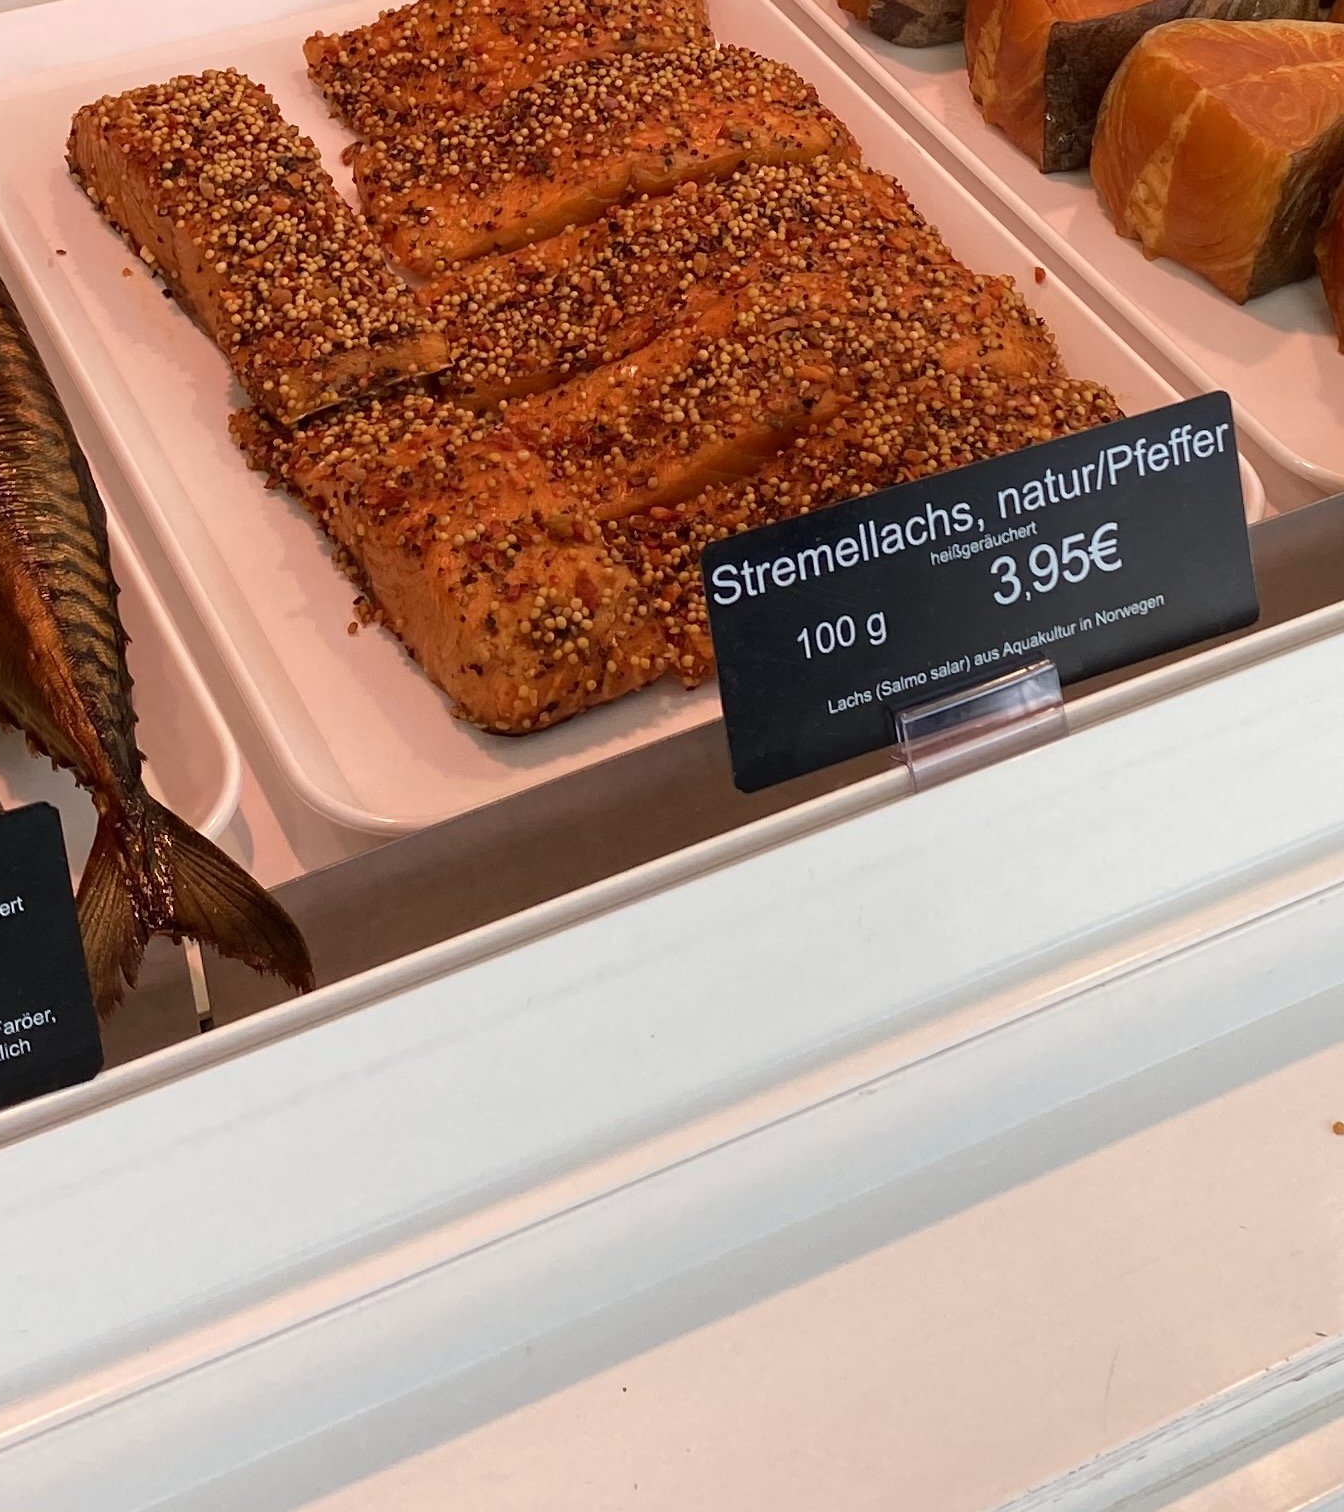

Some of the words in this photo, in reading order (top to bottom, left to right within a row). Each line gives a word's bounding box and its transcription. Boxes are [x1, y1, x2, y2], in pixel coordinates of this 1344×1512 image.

[712, 503, 984, 604] Stremellachs,
[998, 424, 1228, 518] natur/Pfeffer
[931, 522, 1037, 565] heißgeräuchert
[991, 523, 1122, 604] 3,95€
[798, 616, 855, 658] 100
[867, 612, 886, 645] g
[828, 691, 872, 713] Lachs
[876, 673, 926, 701] (Salmo
[931, 656, 970, 680] salar)
[975, 649, 1000, 665] aus
[1003, 624, 1076, 657] Aquakultur
[1080, 619, 1092, 630] in
[1095, 595, 1164, 626] Norwegen
